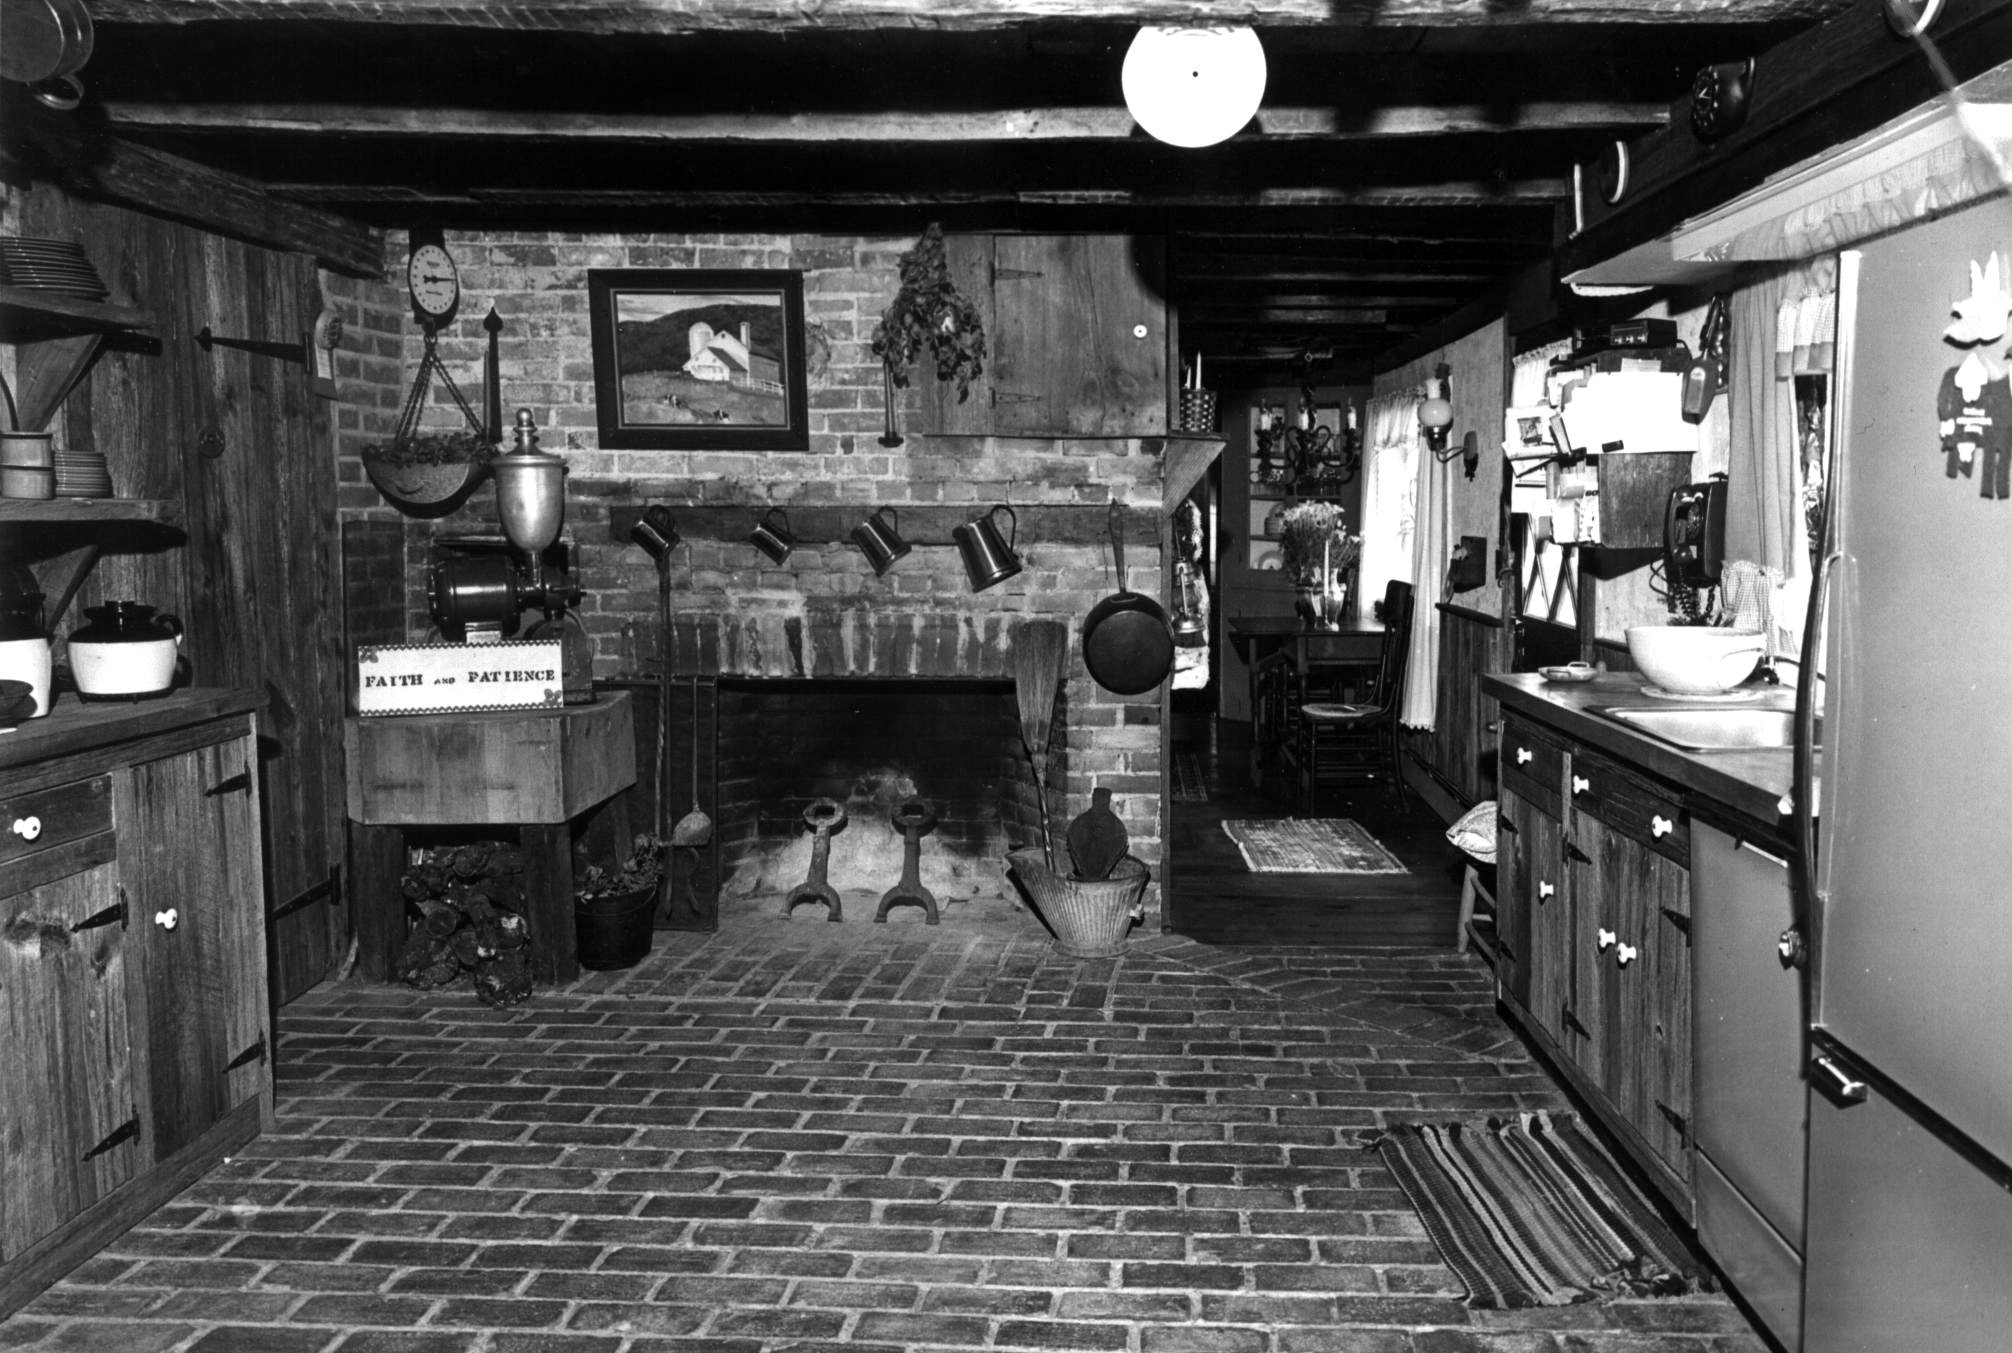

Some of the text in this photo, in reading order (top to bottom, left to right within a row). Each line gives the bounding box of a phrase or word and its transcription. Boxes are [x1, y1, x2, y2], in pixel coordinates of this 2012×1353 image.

[365, 669, 555, 687] FAITH AND PATIENCE
